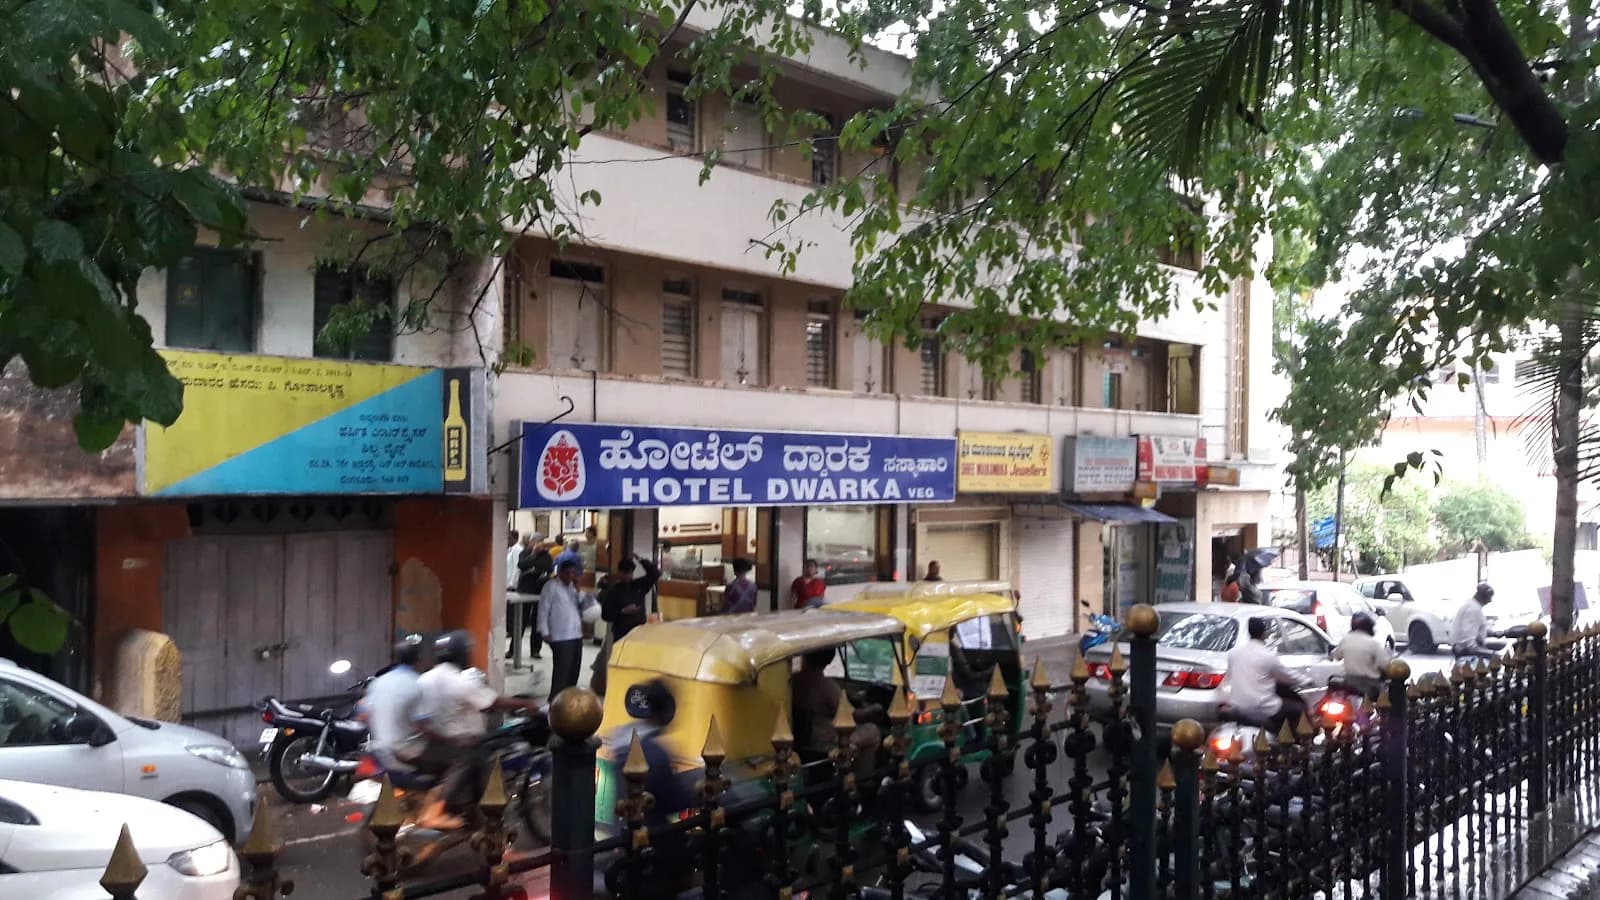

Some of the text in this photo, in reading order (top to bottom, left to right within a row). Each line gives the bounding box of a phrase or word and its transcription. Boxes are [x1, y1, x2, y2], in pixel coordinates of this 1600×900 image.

[599, 429, 948, 478] ಹೋಟೆಲ್ ದ್ವಾರಕ ಸಸ್ಯಾಹಾರಿ
[1009, 463, 1047, 477] Jewellers
[622, 477, 935, 504] HOTEL DWARKA VEG
